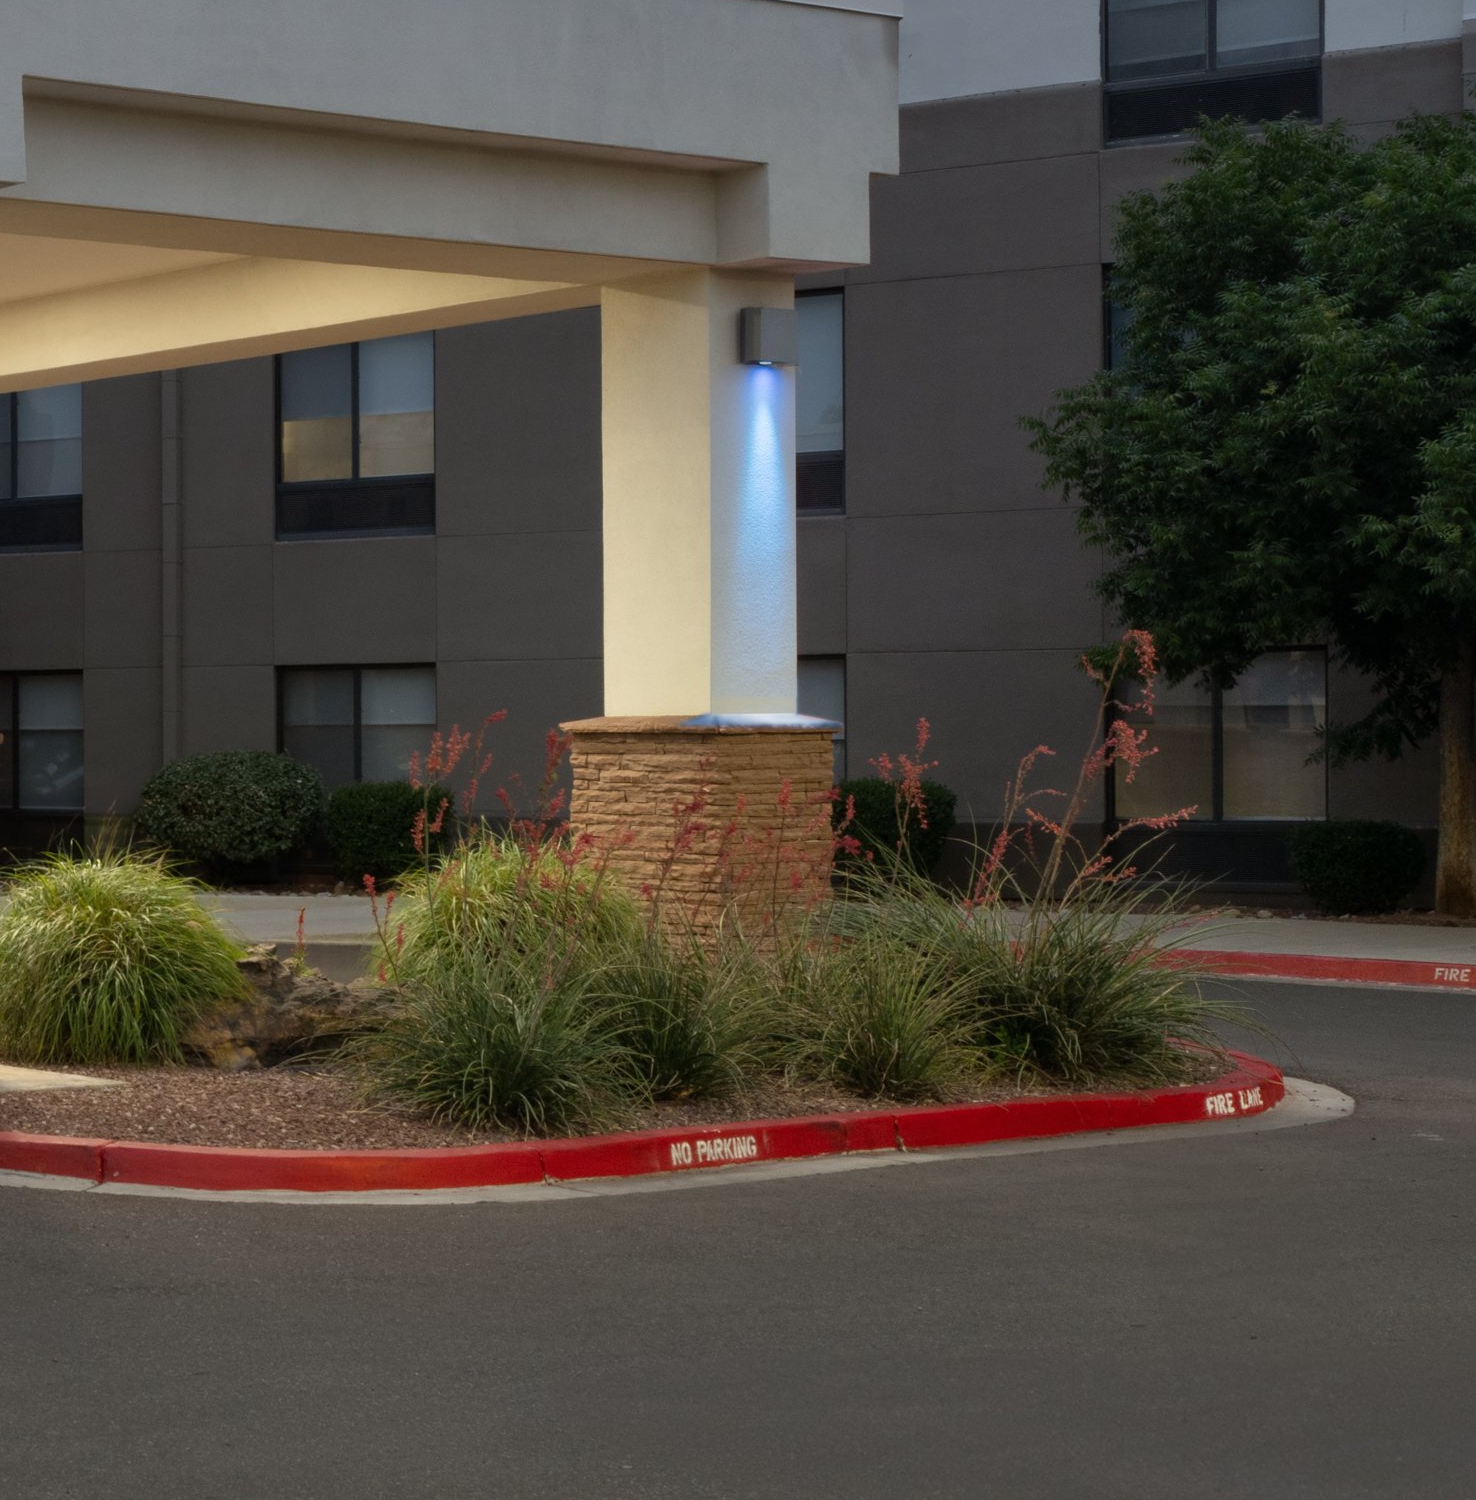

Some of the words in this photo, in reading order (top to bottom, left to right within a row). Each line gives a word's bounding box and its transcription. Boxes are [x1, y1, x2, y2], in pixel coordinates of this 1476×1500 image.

[1434, 967, 1472, 982] FIRE
[1206, 1092, 1235, 1115] FIRE
[1238, 1086, 1263, 1110] LANE
[670, 1142, 693, 1165] NO
[696, 1136, 758, 1162] PARKING
